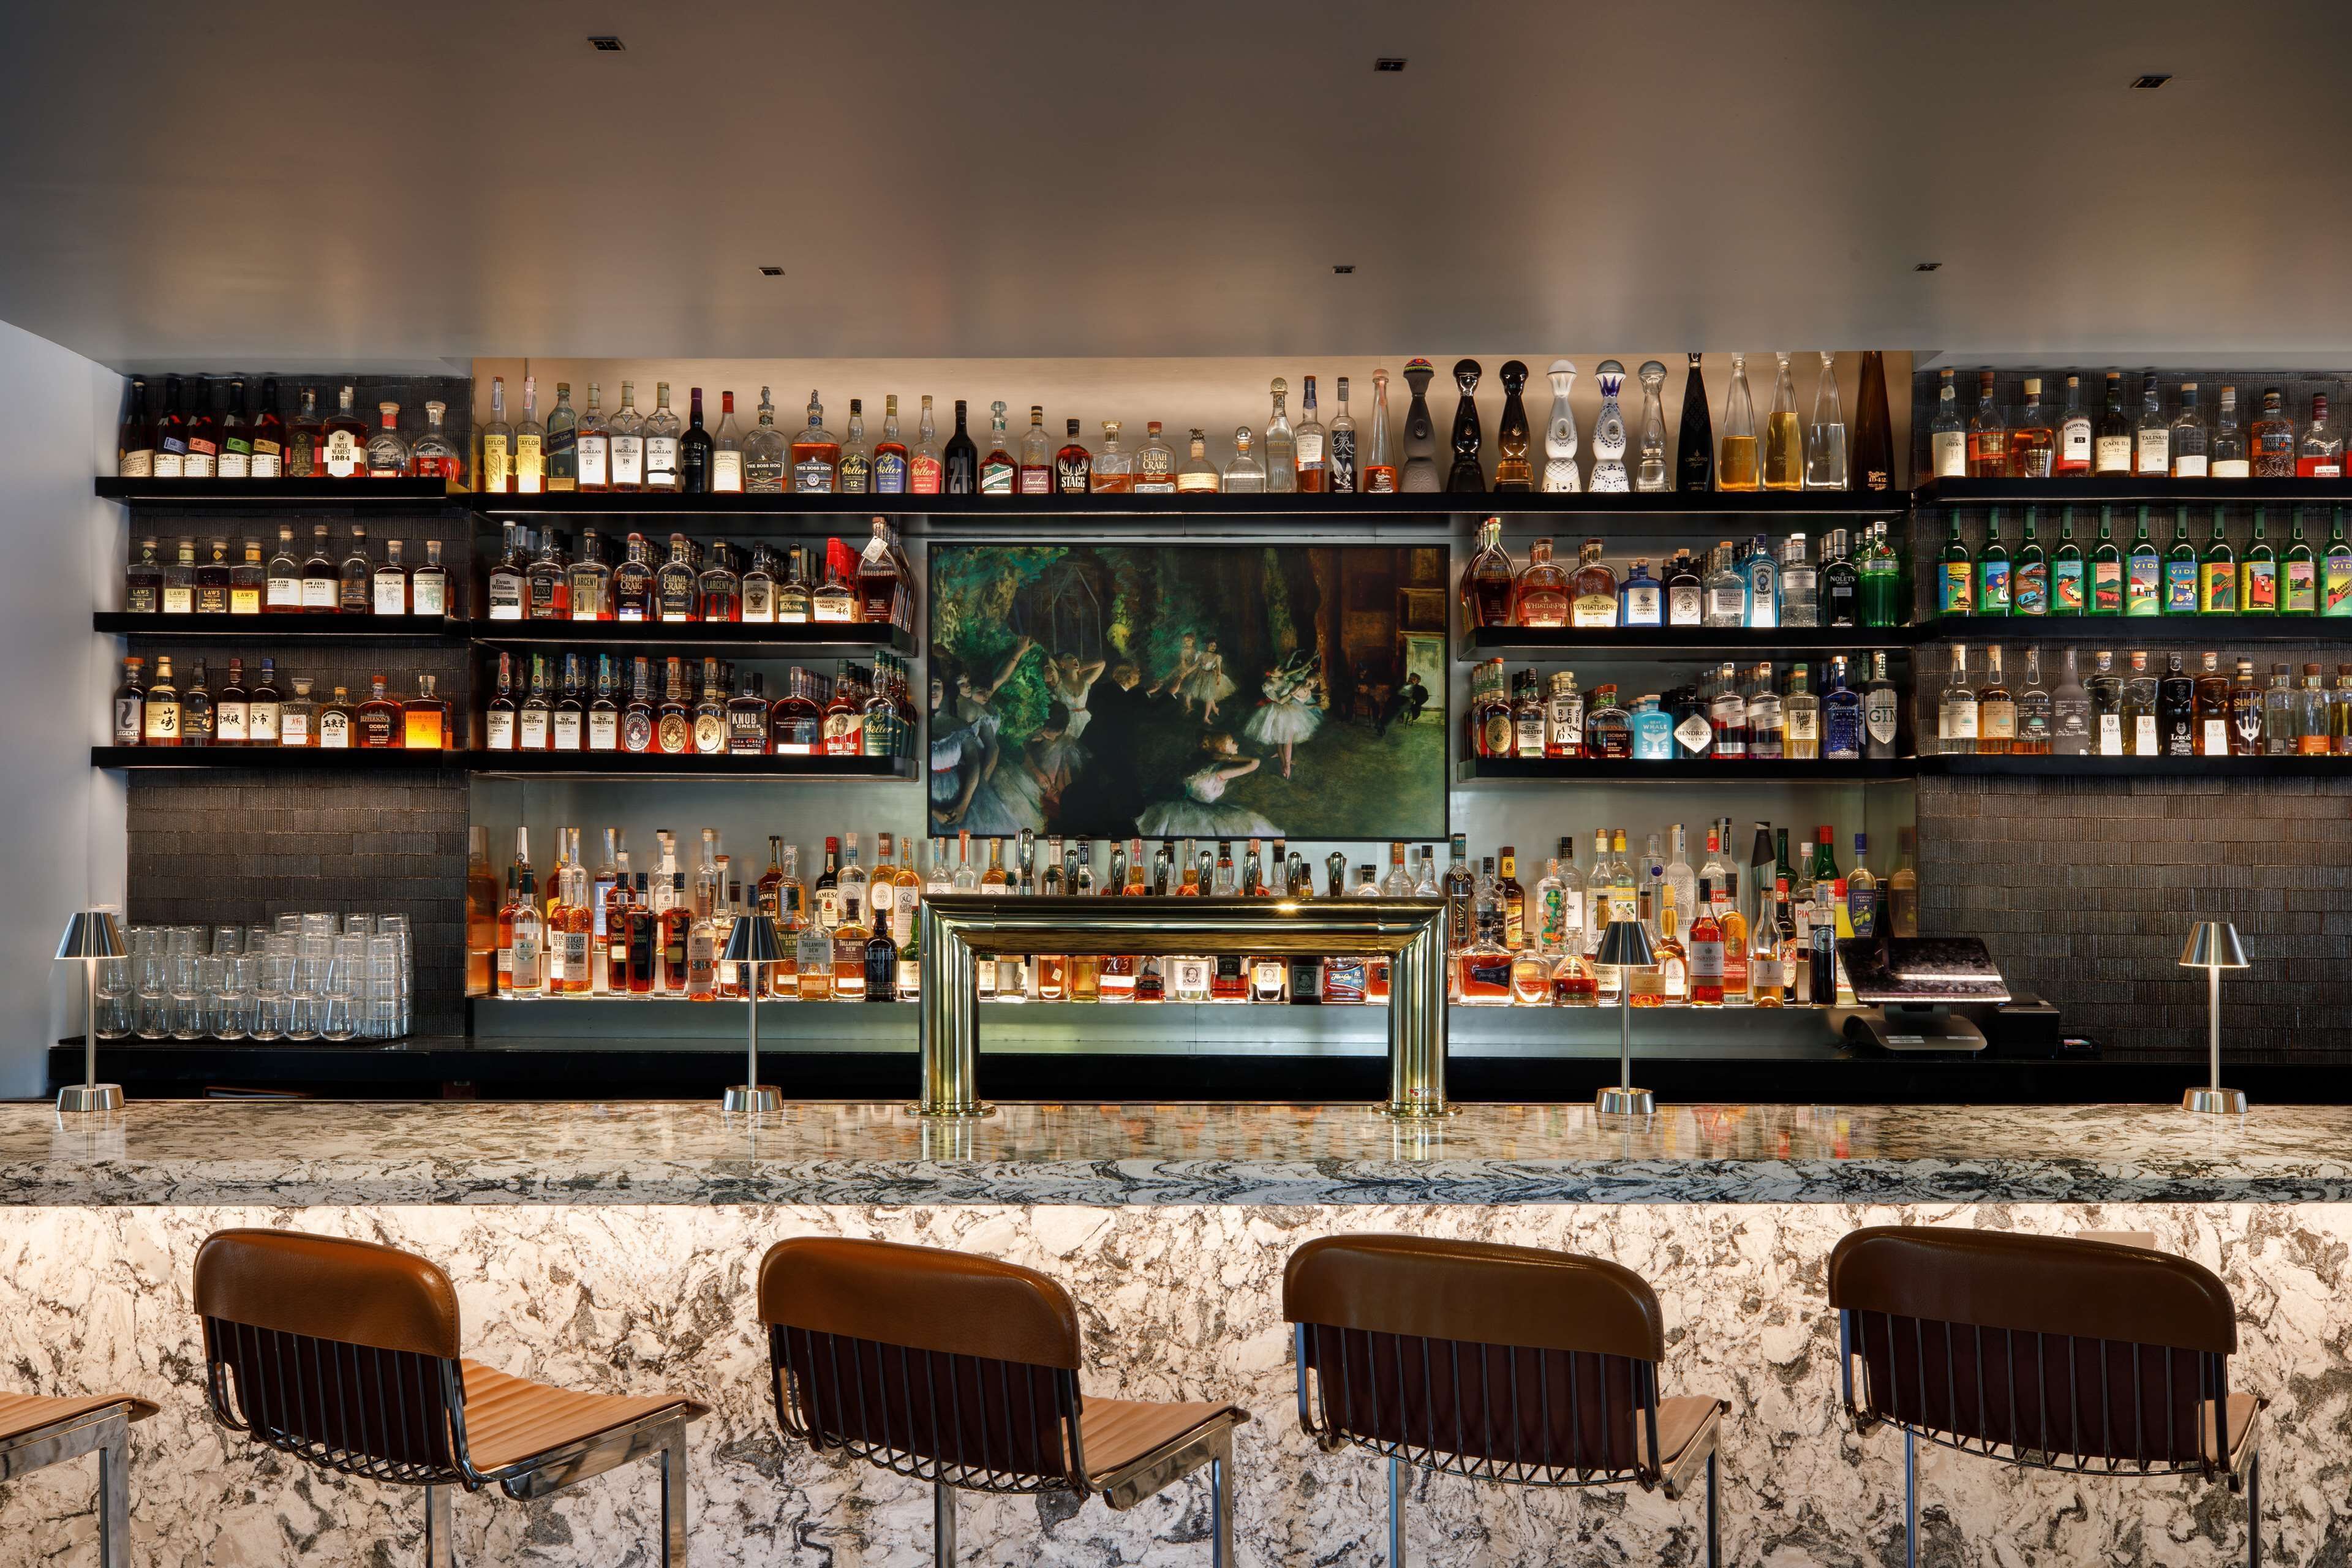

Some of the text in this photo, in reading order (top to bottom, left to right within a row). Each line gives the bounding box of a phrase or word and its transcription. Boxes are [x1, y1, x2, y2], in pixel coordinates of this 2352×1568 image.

[1144, 452, 1167, 461] ELIJAH
[842, 464, 868, 476] Weller
[876, 461, 902, 475] Weller
[911, 462, 937, 476] Weller
[1143, 461, 1167, 470] CRAIG
[949, 456, 968, 494] 21
[1023, 475, 1047, 485] Bourbon
[1061, 477, 1085, 488] STAGG
[574, 577, 597, 587] LARCENY
[620, 581, 643, 590] CRAIG
[663, 581, 686, 590] CRAIG
[706, 579, 729, 589] LARCENY
[836, 607, 848, 616] 46
[732, 713, 757, 725] KNOB
[1869, 709, 1897, 723] GIN
[865, 721, 894, 734] Weller
[1456, 903, 1466, 928] Zaya
